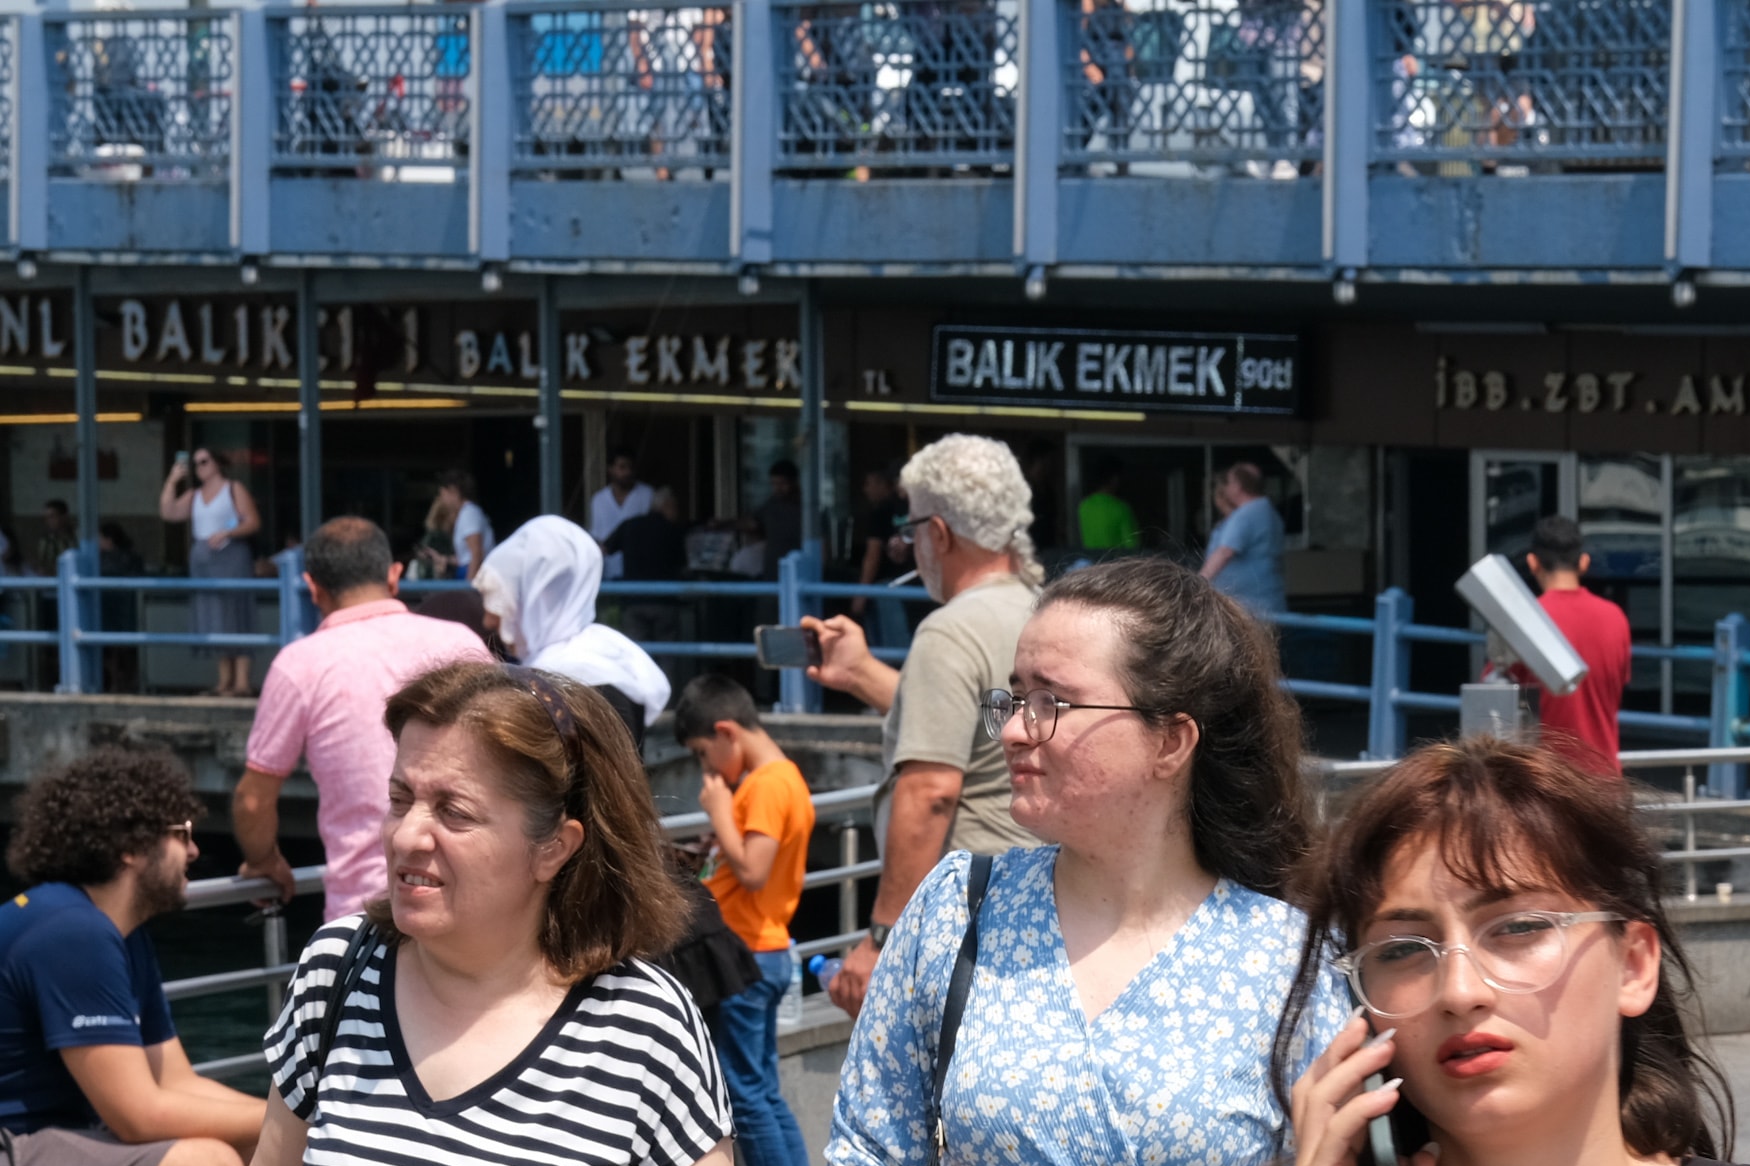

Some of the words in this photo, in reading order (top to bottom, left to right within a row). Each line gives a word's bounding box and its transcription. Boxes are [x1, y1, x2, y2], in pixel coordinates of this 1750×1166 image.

[455, 330, 592, 380] BALK
[625, 335, 801, 390] EKMEK
[862, 369, 891, 395] TL
[945, 338, 1066, 392] BALIK
[1075, 342, 1227, 397] EKMEK
